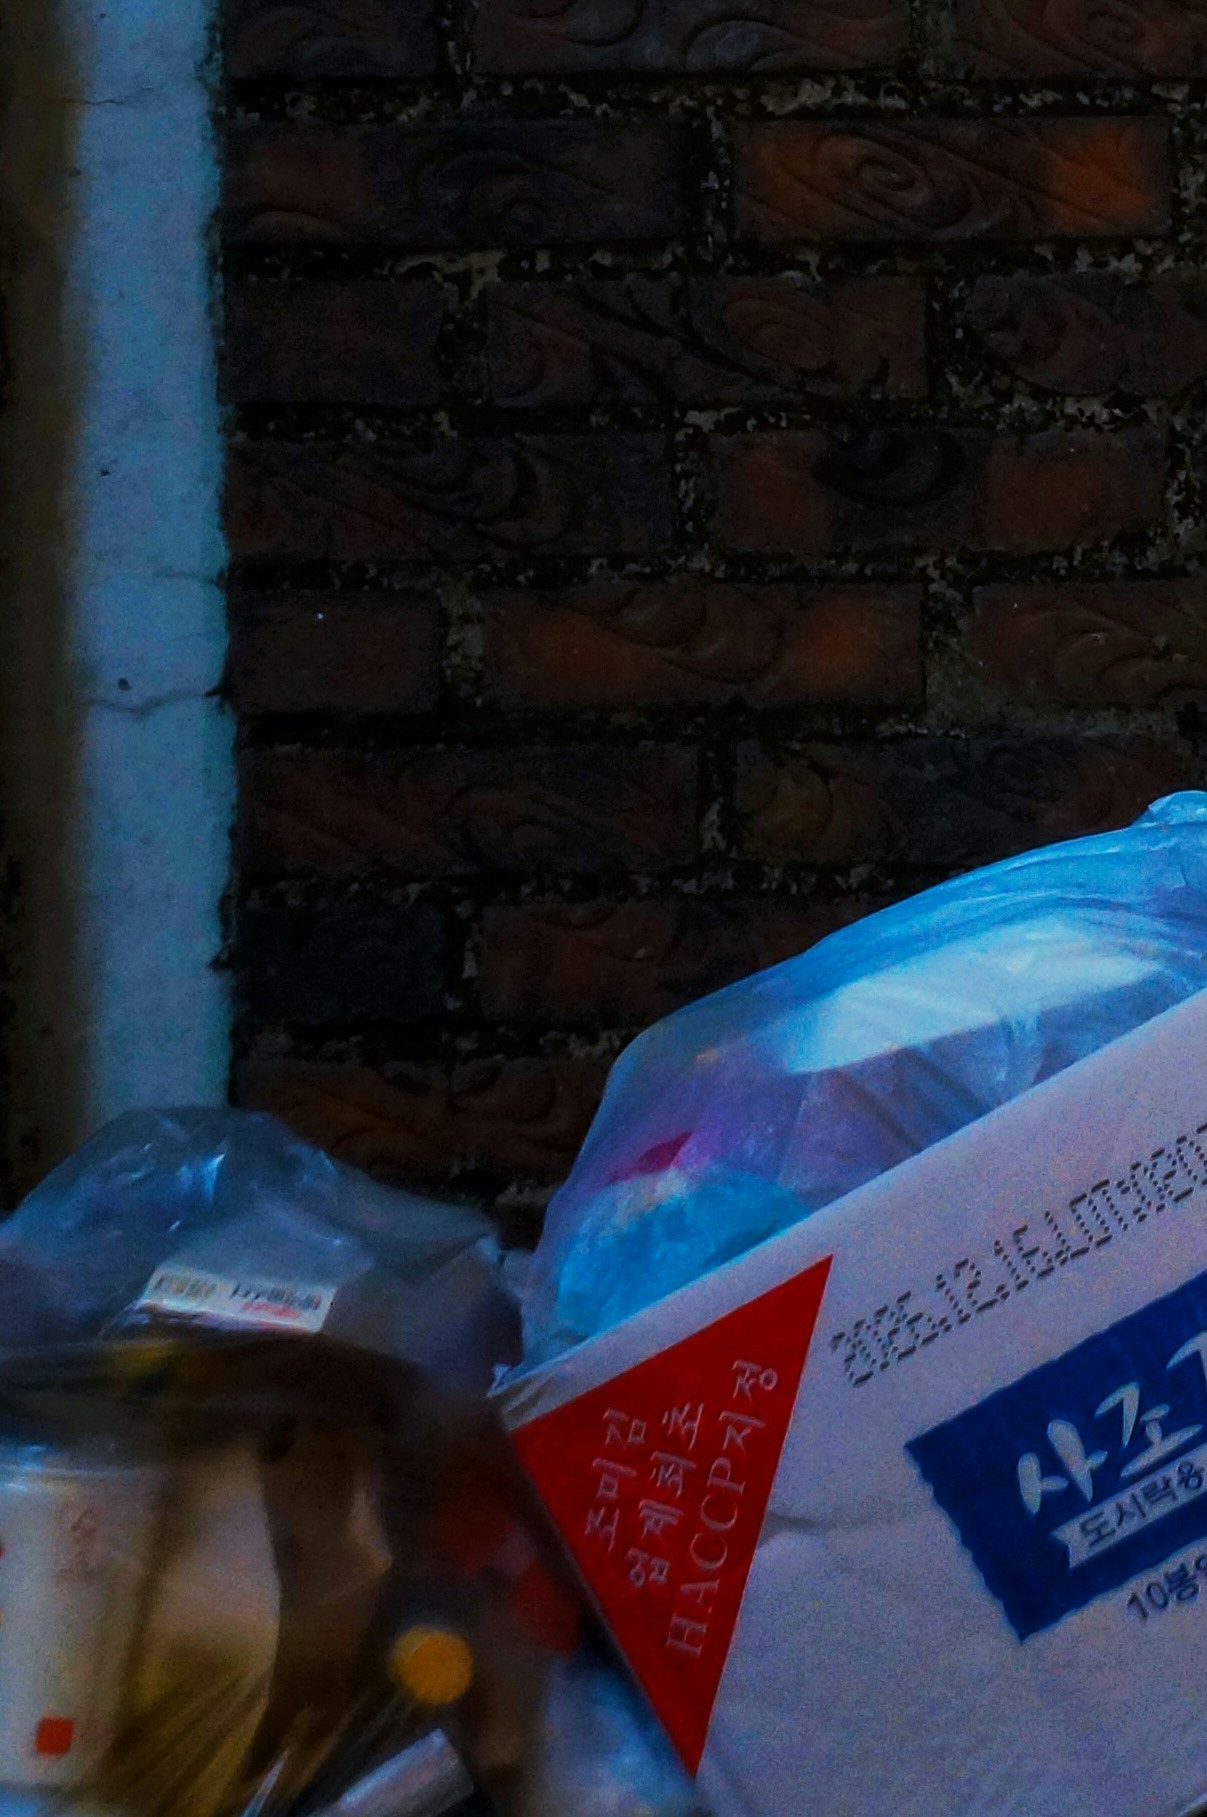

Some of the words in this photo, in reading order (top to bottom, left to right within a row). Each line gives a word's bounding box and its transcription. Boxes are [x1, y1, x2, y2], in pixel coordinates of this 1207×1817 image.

[584, 1406, 648, 1553] 조미김
[624, 1401, 704, 1586] 업계최초
[1078, 1460, 1206, 1548] 도시락용
